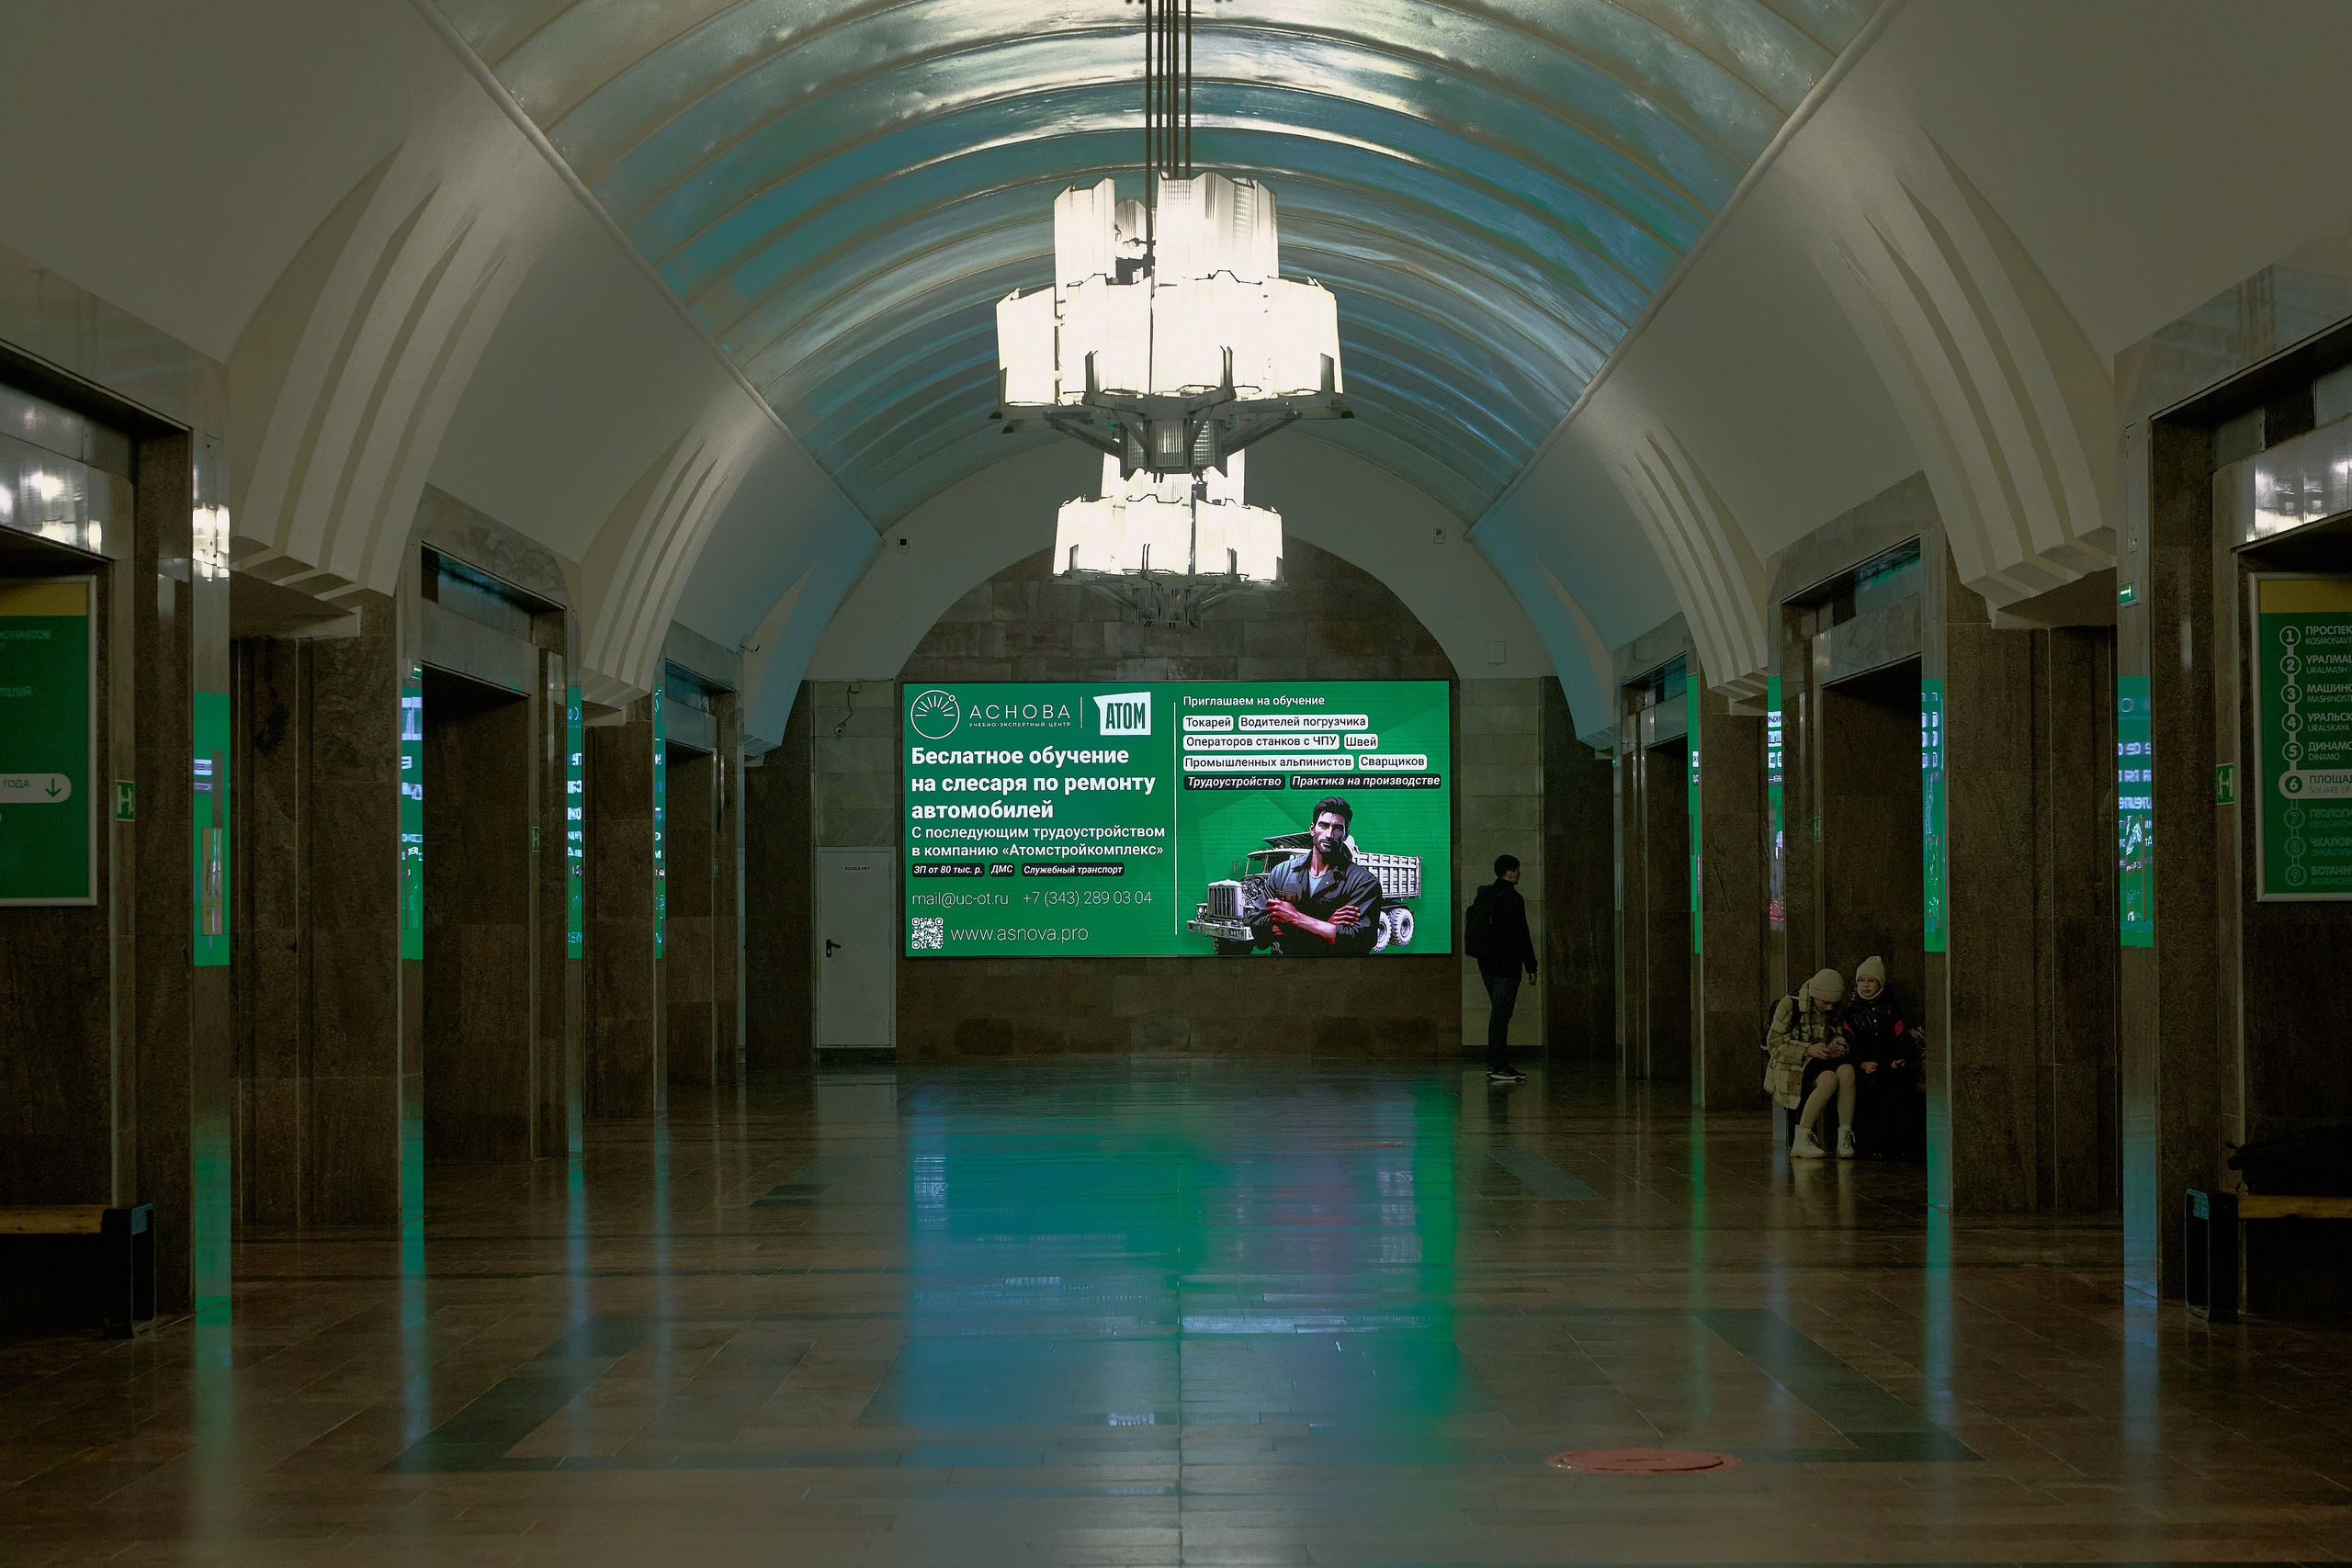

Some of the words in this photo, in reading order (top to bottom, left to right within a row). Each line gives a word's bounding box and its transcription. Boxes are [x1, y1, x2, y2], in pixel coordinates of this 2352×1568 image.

[2287, 630, 2294, 642] 1
[2305, 626, 2352, 635] ПРОСПЕК
[2287, 659, 2295, 671] 2
[2306, 666, 2347, 674] URALMASH
[2287, 688, 2296, 700] 3
[2307, 694, 2352, 703] MASHINOST
[1183, 696, 1254, 708] Приглашаем
[1257, 697, 1271, 705] на
[1272, 695, 1325, 707] обучение
[968, 705, 1070, 719] АСНОВА
[1105, 702, 1146, 728] АТОМ
[1185, 717, 1231, 729] Токарей
[1241, 716, 1300, 728] Водителей
[1304, 717, 1366, 728] погрузчика
[2287, 716, 2297, 728] 4
[2308, 724, 2350, 732] URALSKAYA
[1186, 738, 1252, 748] Операторов
[1256, 738, 1300, 746] станков
[1313, 736, 1337, 746] ЧПУ
[1346, 735, 1376, 747] Швей
[911, 747, 1023, 764] Беслатное
[1029, 746, 1129, 768] обучение
[2289, 745, 2298, 758] 5
[1185, 757, 1276, 769] Промышленных
[1280, 757, 1351, 767] альпинистов
[1361, 757, 1424, 769] Сварщиков
[4, 780, 29, 788] ГОДА
[911, 778, 935, 792] на
[941, 777, 1027, 795] слесаря
[1034, 777, 1058, 791] по
[1064, 776, 1156, 795] ремонту
[1188, 776, 1282, 788] Трудоустройство
[1292, 775, 1344, 787] Практика
[1348, 777, 1360, 785] на
[1363, 776, 1441, 787] производстве
[2289, 778, 2298, 791] 6
[2310, 786, 2338, 795] SQUARE
[911, 800, 1054, 818] автомобилей
[2290, 811, 2300, 825] 7
[911, 827, 922, 839] С
[925, 829, 1029, 840] последующим
[1033, 825, 1165, 840] трудоустройством
[911, 847, 921, 856] в
[924, 846, 998, 856] компанию
[1002, 843, 1164, 858] «Атомстройкомплекс»
[2290, 840, 2300, 853] 8
[913, 865, 926, 874] ЗП
[941, 865, 951, 874] 80
[953, 866, 973, 874] тыс.
[974, 867, 982, 875] р.
[990, 864, 1013, 874] ДМС
[1023, 865, 1075, 875] Служебный
[1078, 866, 1123, 875] транспорт
[2291, 868, 2301, 882] 9
[912, 892, 1008, 908] mail@uc-ot.ru
[1023, 892, 1039, 905] +7
[1044, 891, 1080, 908] (343)
[1084, 891, 1110, 905] 289
[1114, 891, 1131, 905] 03
[1135, 891, 1152, 905] 04
[950, 927, 1089, 943] www.asnova.pro
